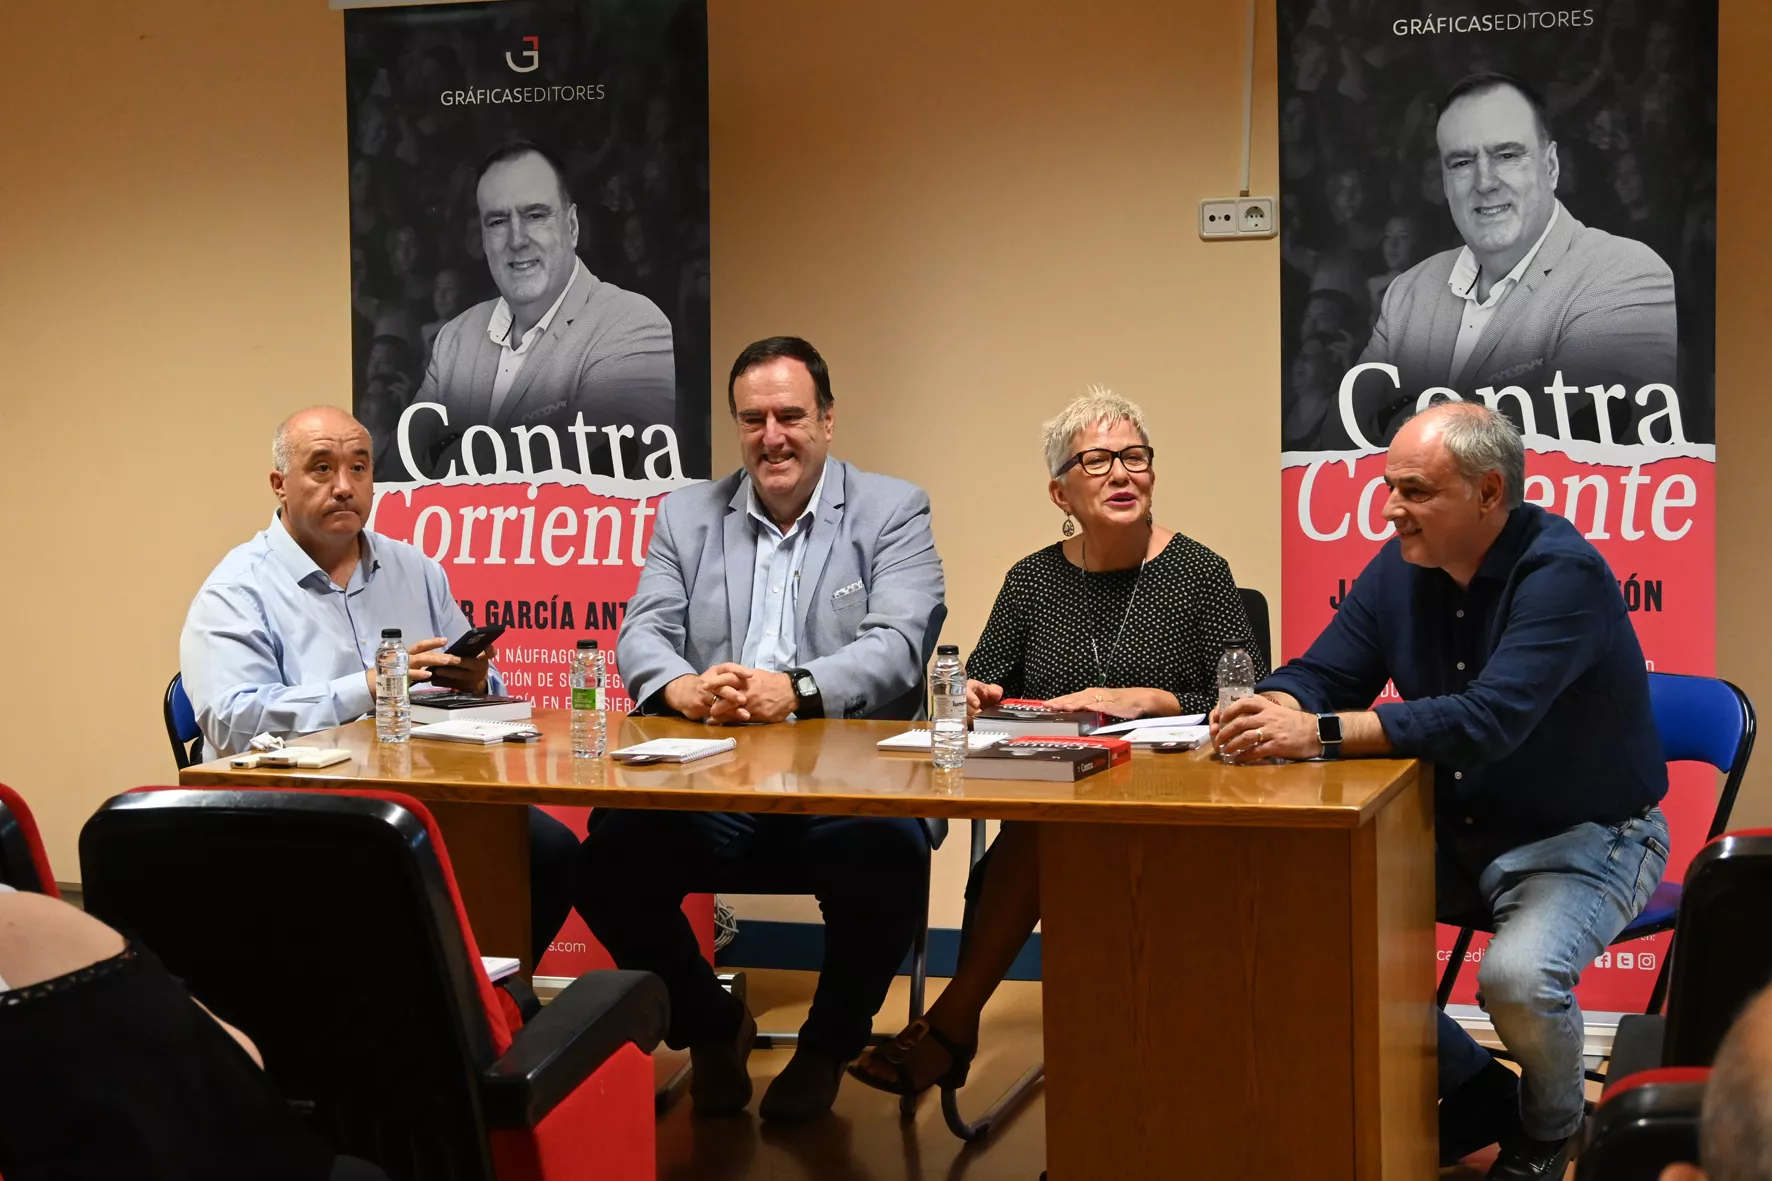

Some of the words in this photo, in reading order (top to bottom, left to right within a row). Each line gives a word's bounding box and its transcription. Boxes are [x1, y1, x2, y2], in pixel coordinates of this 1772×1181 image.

[1392, 9, 1595, 36] GRÁFICASEDITORES
[440, 84, 606, 106] GRÁFICASEDITORES
[396, 401, 693, 482] Contra
[485, 594, 575, 630] GARCÍA
[537, 672, 554, 687] DE
